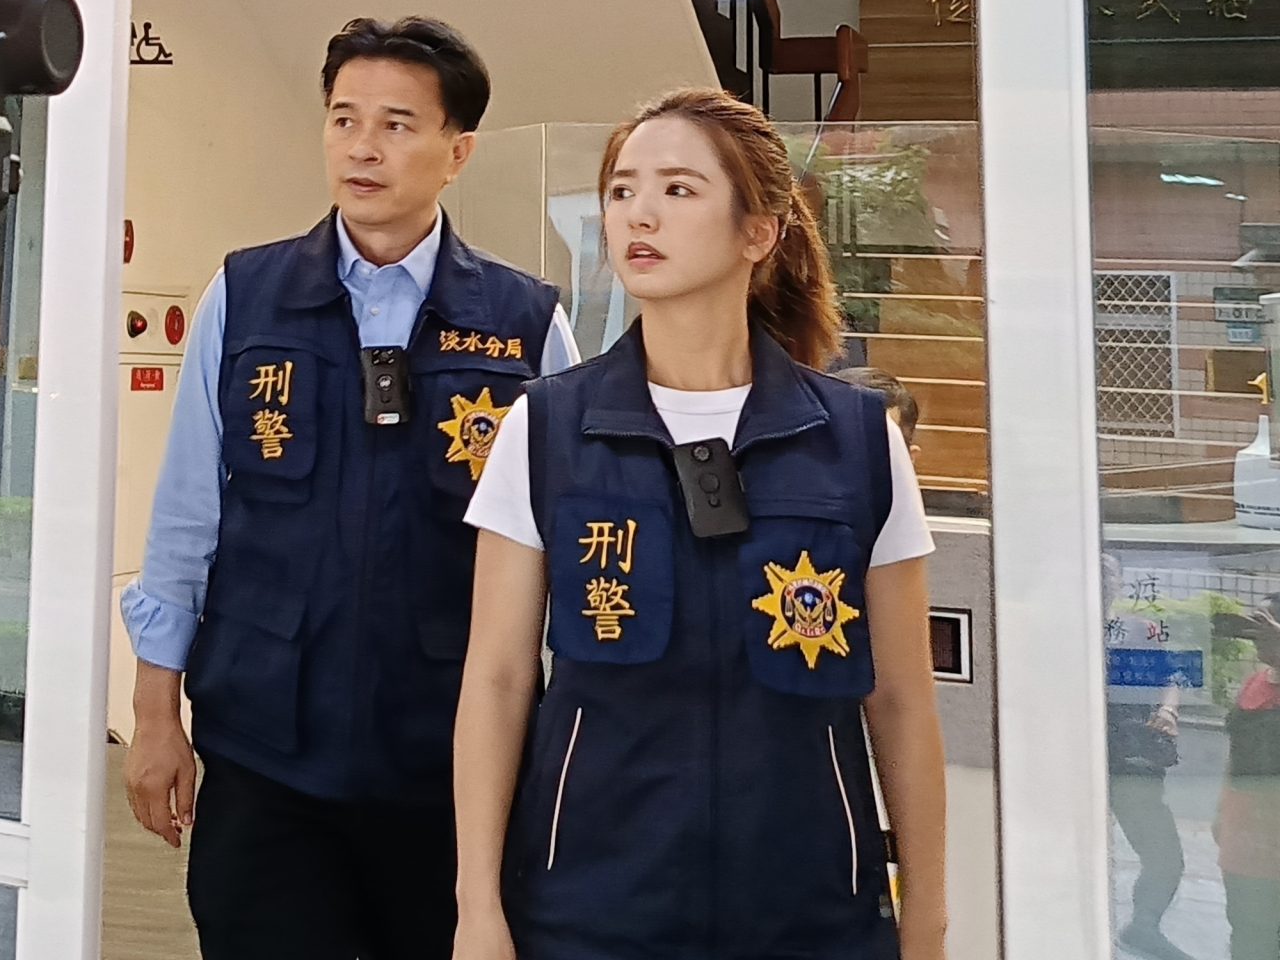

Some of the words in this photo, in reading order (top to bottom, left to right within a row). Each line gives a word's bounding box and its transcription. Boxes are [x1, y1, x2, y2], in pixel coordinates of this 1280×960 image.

[440, 329, 523, 359] 淡水分局
[249, 360, 294, 460] 刑警
[578, 519, 637, 641] 刑警
